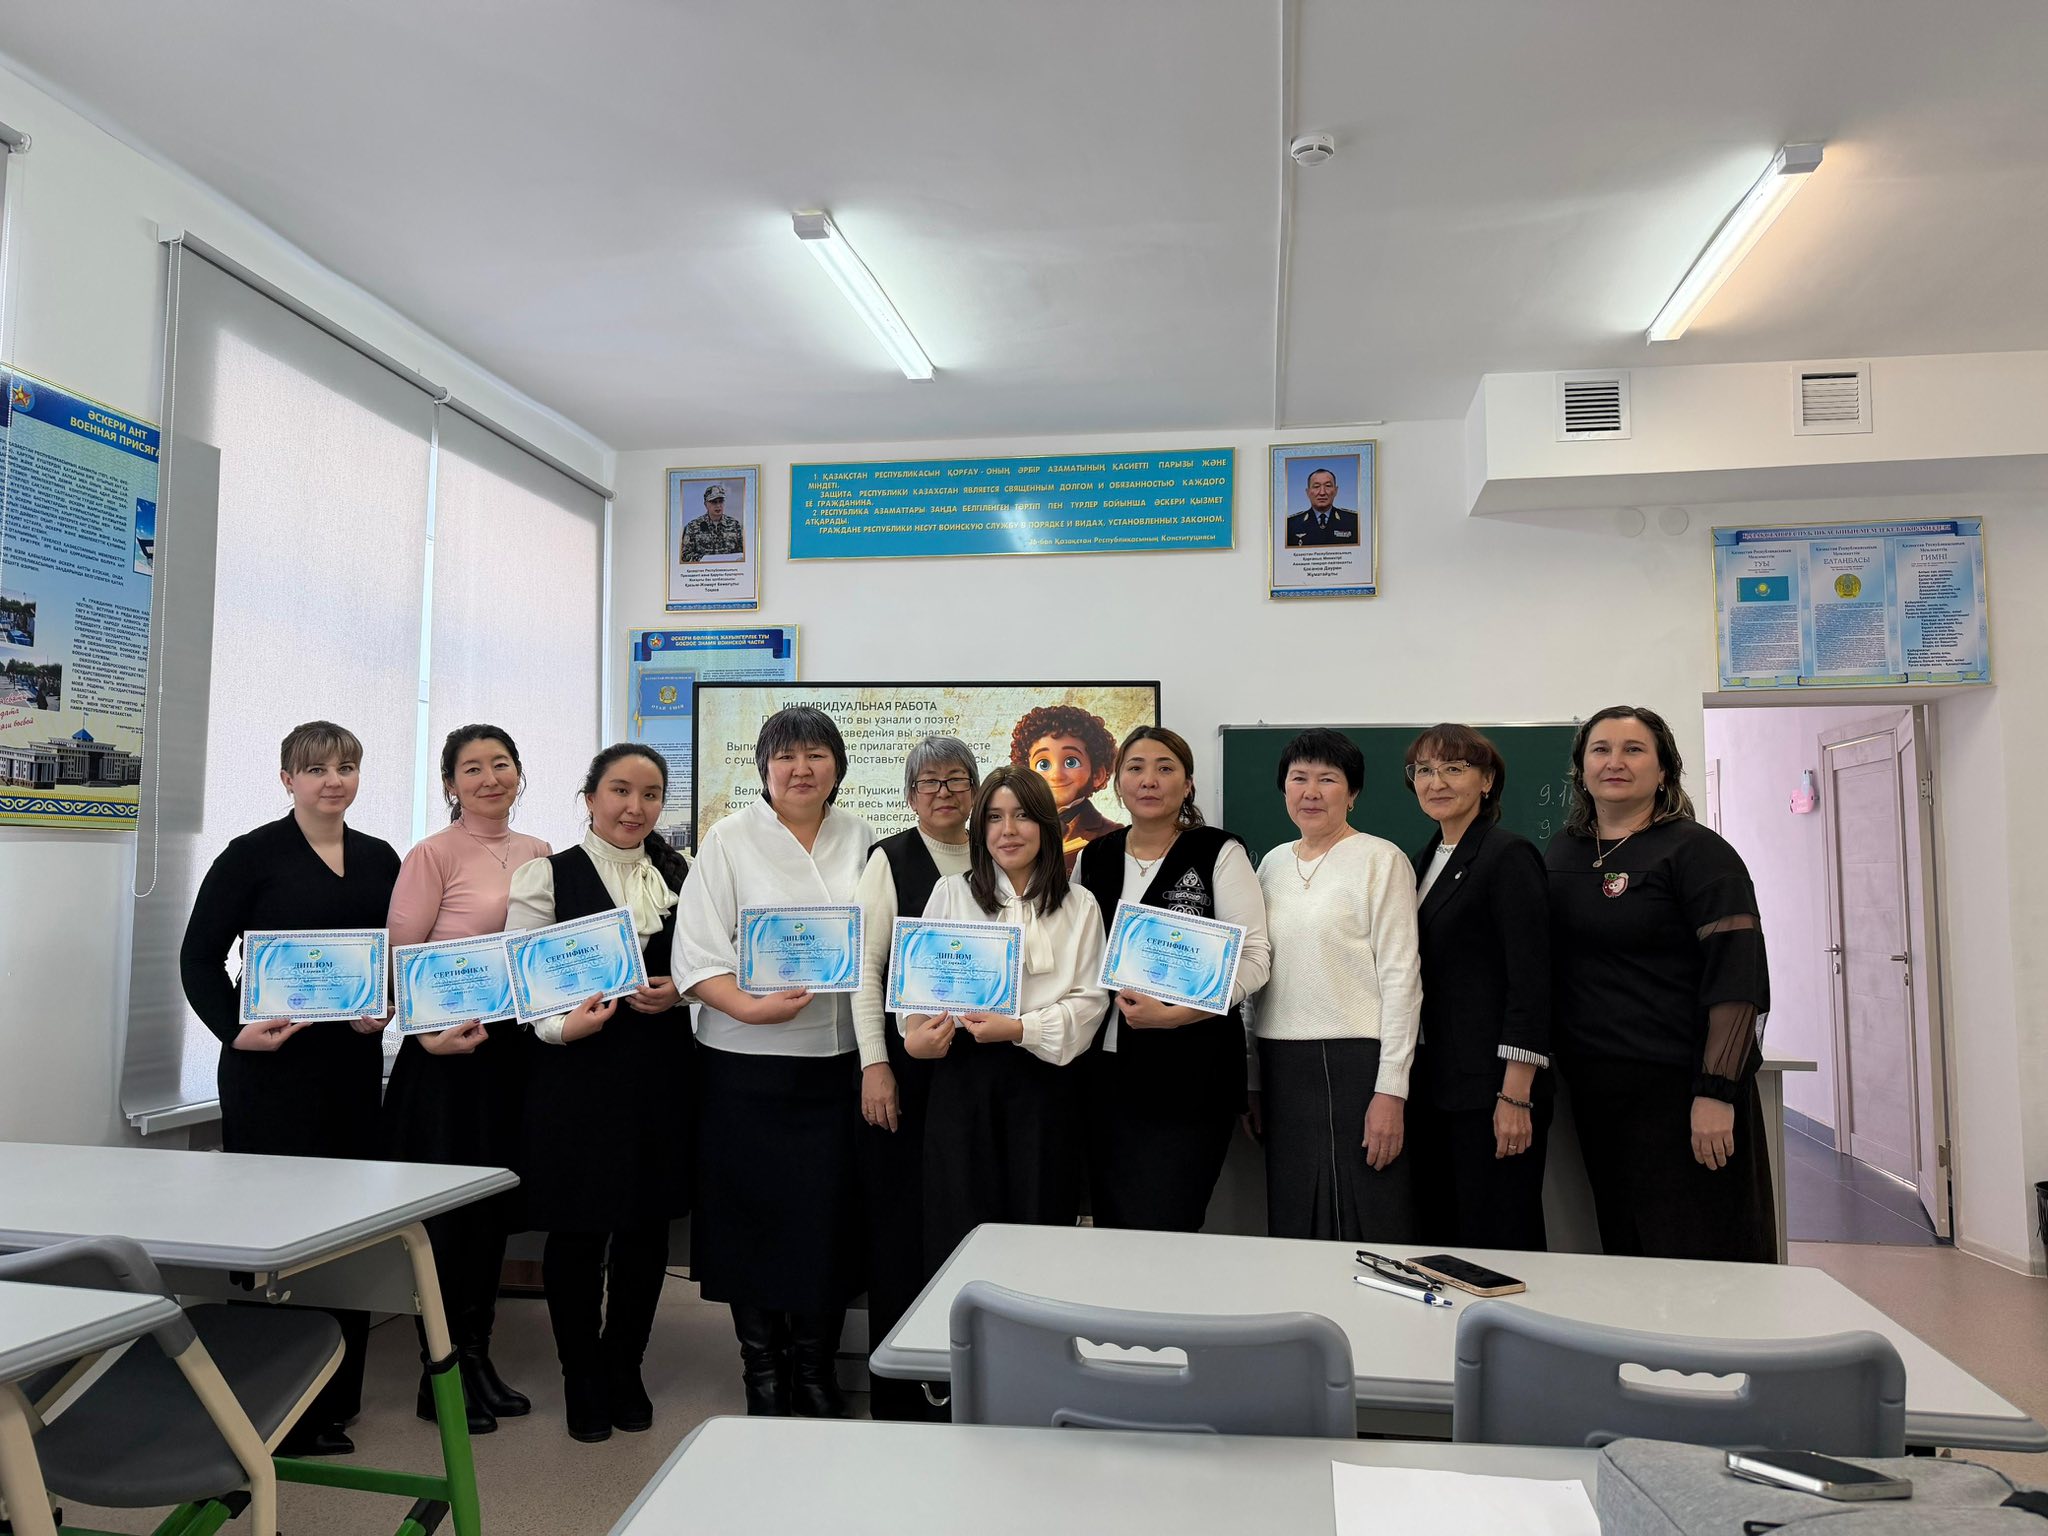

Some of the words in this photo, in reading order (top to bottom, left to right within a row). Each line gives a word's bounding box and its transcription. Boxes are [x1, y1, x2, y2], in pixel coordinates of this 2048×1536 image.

[70, 416, 116, 442] ВОЕННАЯ
[88, 410, 126, 432] ӘСКЕРИ
[128, 426, 148, 440] АНТ
[822, 472, 868, 480] ҚАЗАҚСТАН
[875, 470, 940, 478] РЕСПУБЛИКАСЫН
[913, 488, 958, 496] КАЗАХСТАН
[1004, 484, 1055, 492] СВЯЩЕННЫМ
[1060, 483, 1093, 491] ДОЛГОМ
[1110, 480, 1174, 488] ОБЯЗАННОСТЬЮ
[1182, 478, 1226, 486] КАЖДОГО
[818, 500, 874, 508] ГРАЖДАНИНА.
[820, 508, 868, 516] РЕСПУБЛИКА
[874, 506, 926, 514] АЗАМАТТАРЫ
[962, 504, 1010, 512] БЕЛГІЛЕНГЕН
[1104, 499, 1146, 508] БОЙЫНША
[1154, 498, 1185, 506] ӘСКЕРИ
[1190, 496, 1223, 505] ҚЫЗМЕТ
[820, 526, 862, 534] ГРАЖДАНЕ
[864, 525, 912, 533] РЕСПУБЛИКИ
[939, 522, 983, 530] ВОИНСКУЮ
[1028, 520, 1064, 528] ПОРЯДКЕ
[1108, 517, 1178, 526] УСТАНОВЛЕННЫХ
[783, 702, 892, 712] ИНДИВИДУАЛЬНАЯ
[895, 702, 937, 710] РАБОТА
[834, 716, 853, 724] Что
[874, 717, 912, 726] узнали
[924, 715, 959, 724] поэте?
[840, 730, 894, 738] зведения
[916, 728, 957, 738] знаете?
[727, 742, 756, 751] Выпи
[860, 743, 916, 752] прилагате
[725, 756, 731, 764] с
[848, 755, 906, 764] Поставьте
[735, 786, 761, 795] Вели
[858, 786, 900, 796] Пушкин
[836, 800, 855, 808] бит
[867, 814, 916, 822] навсегда
[1146, 938, 1200, 954] СЕРТИФИКАТ
[545, 944, 600, 964] СЕРТИФИКАТ
[935, 952, 972, 960] ДИПЛОМ
[294, 962, 333, 970] ДИПЛОМ
[434, 966, 489, 978] СЕРТИФИКАТ
